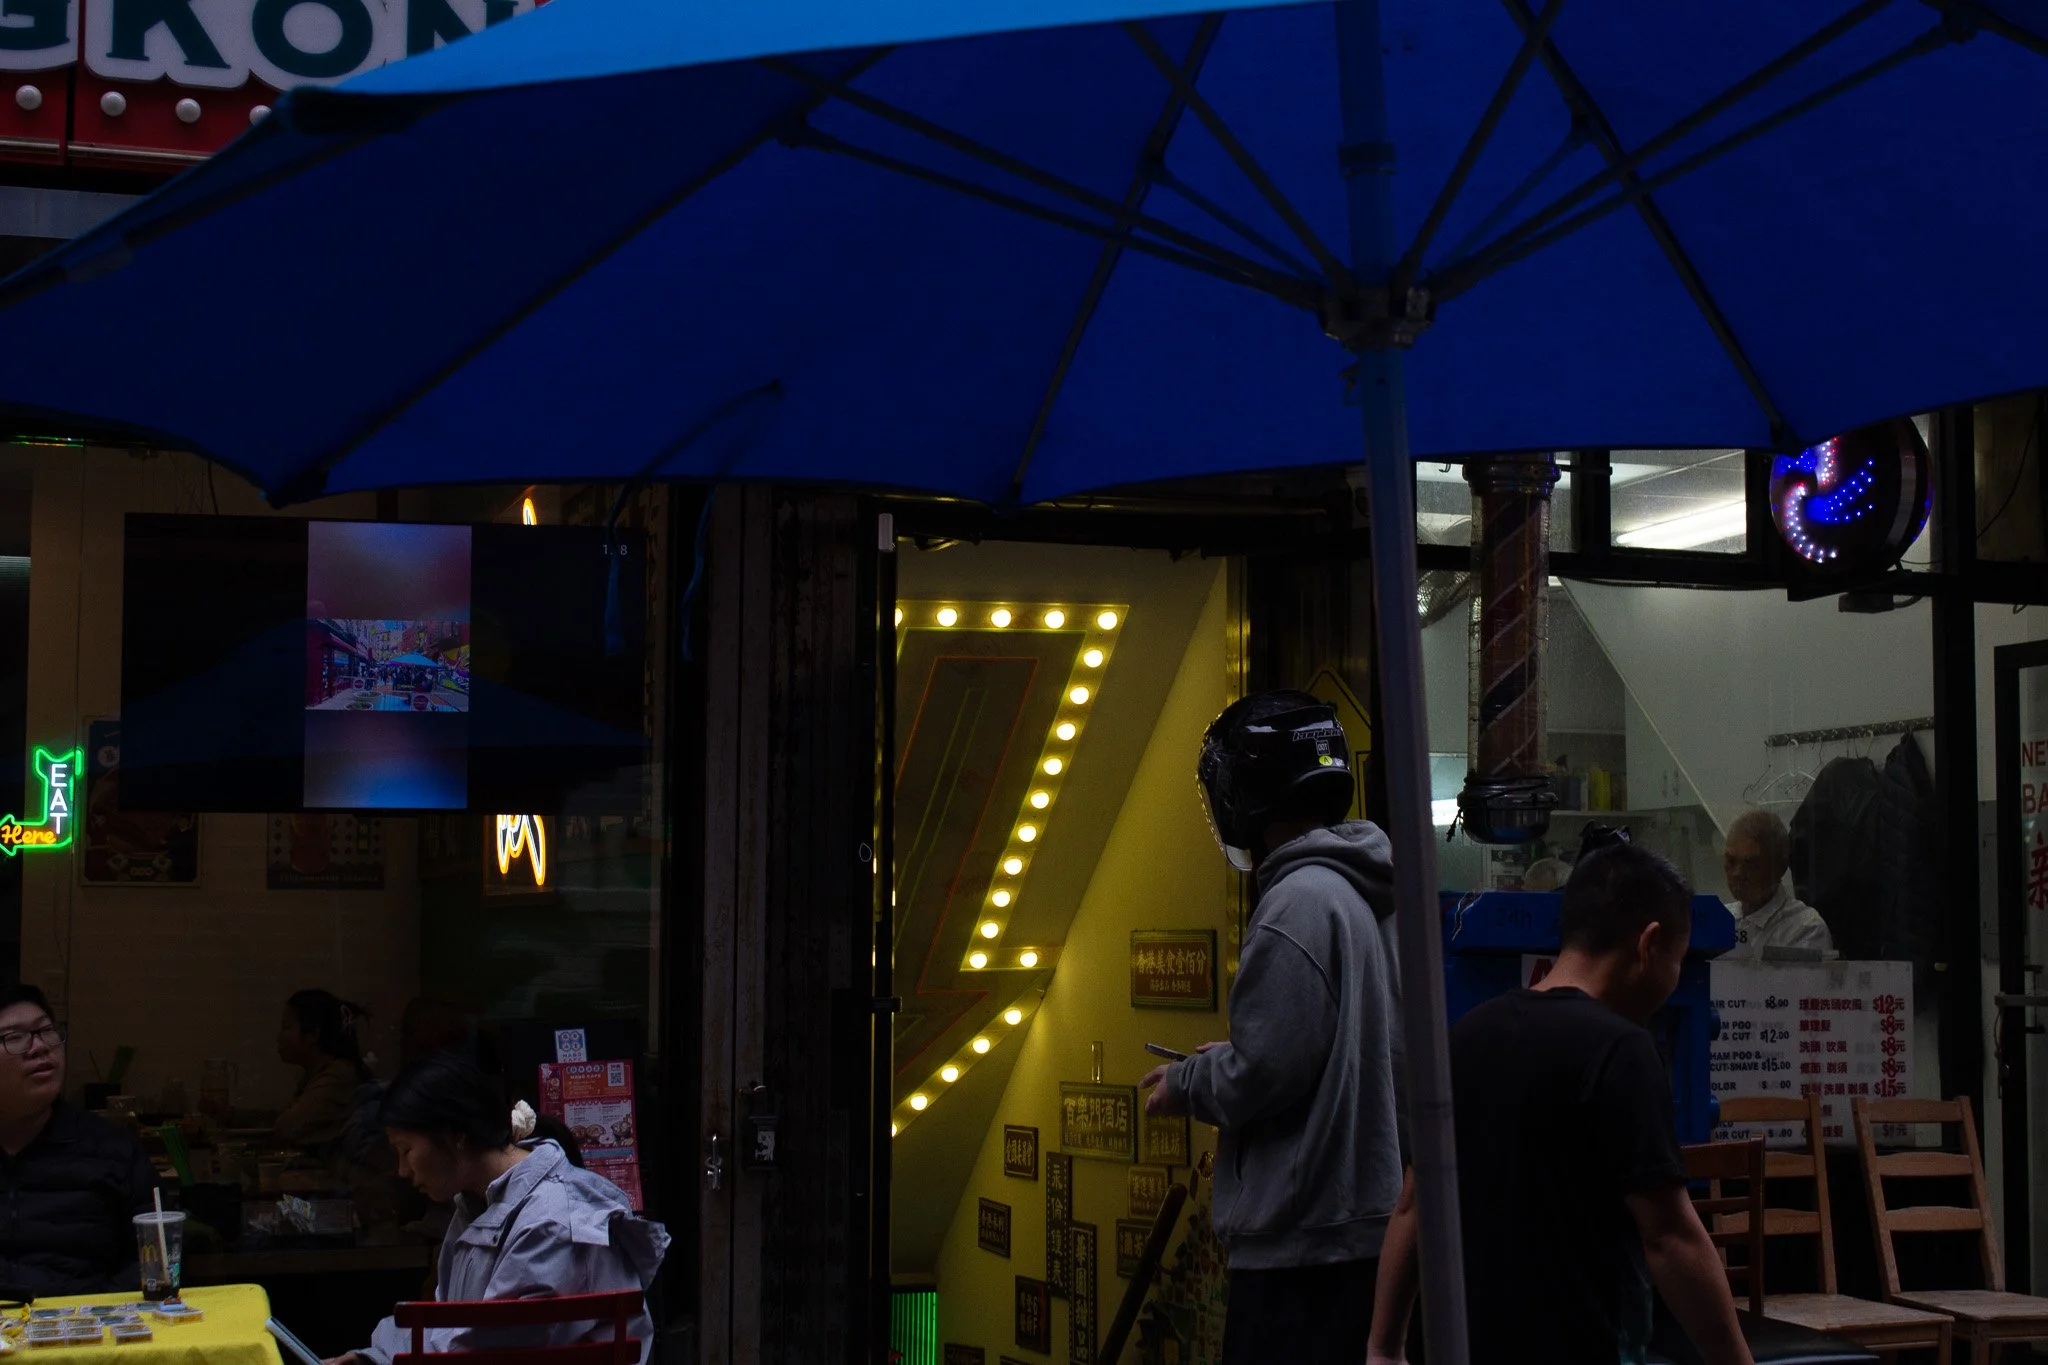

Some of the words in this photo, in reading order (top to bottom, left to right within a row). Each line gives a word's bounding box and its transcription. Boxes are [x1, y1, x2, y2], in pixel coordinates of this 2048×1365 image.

[2022, 740, 2048, 768] NE
[49, 763, 68, 835] EAT
[0, 824, 57, 845] Here
[1709, 1000, 1725, 1009] AIR
[1727, 999, 1747, 1009] CUT
[1732, 1032, 1751, 1041] CUT
[1710, 1051, 1730, 1060] HAM
[1733, 1051, 1752, 1060] POO
[1711, 1082, 1736, 1091] OLOR
[1731, 1130, 1750, 1139] CUT
